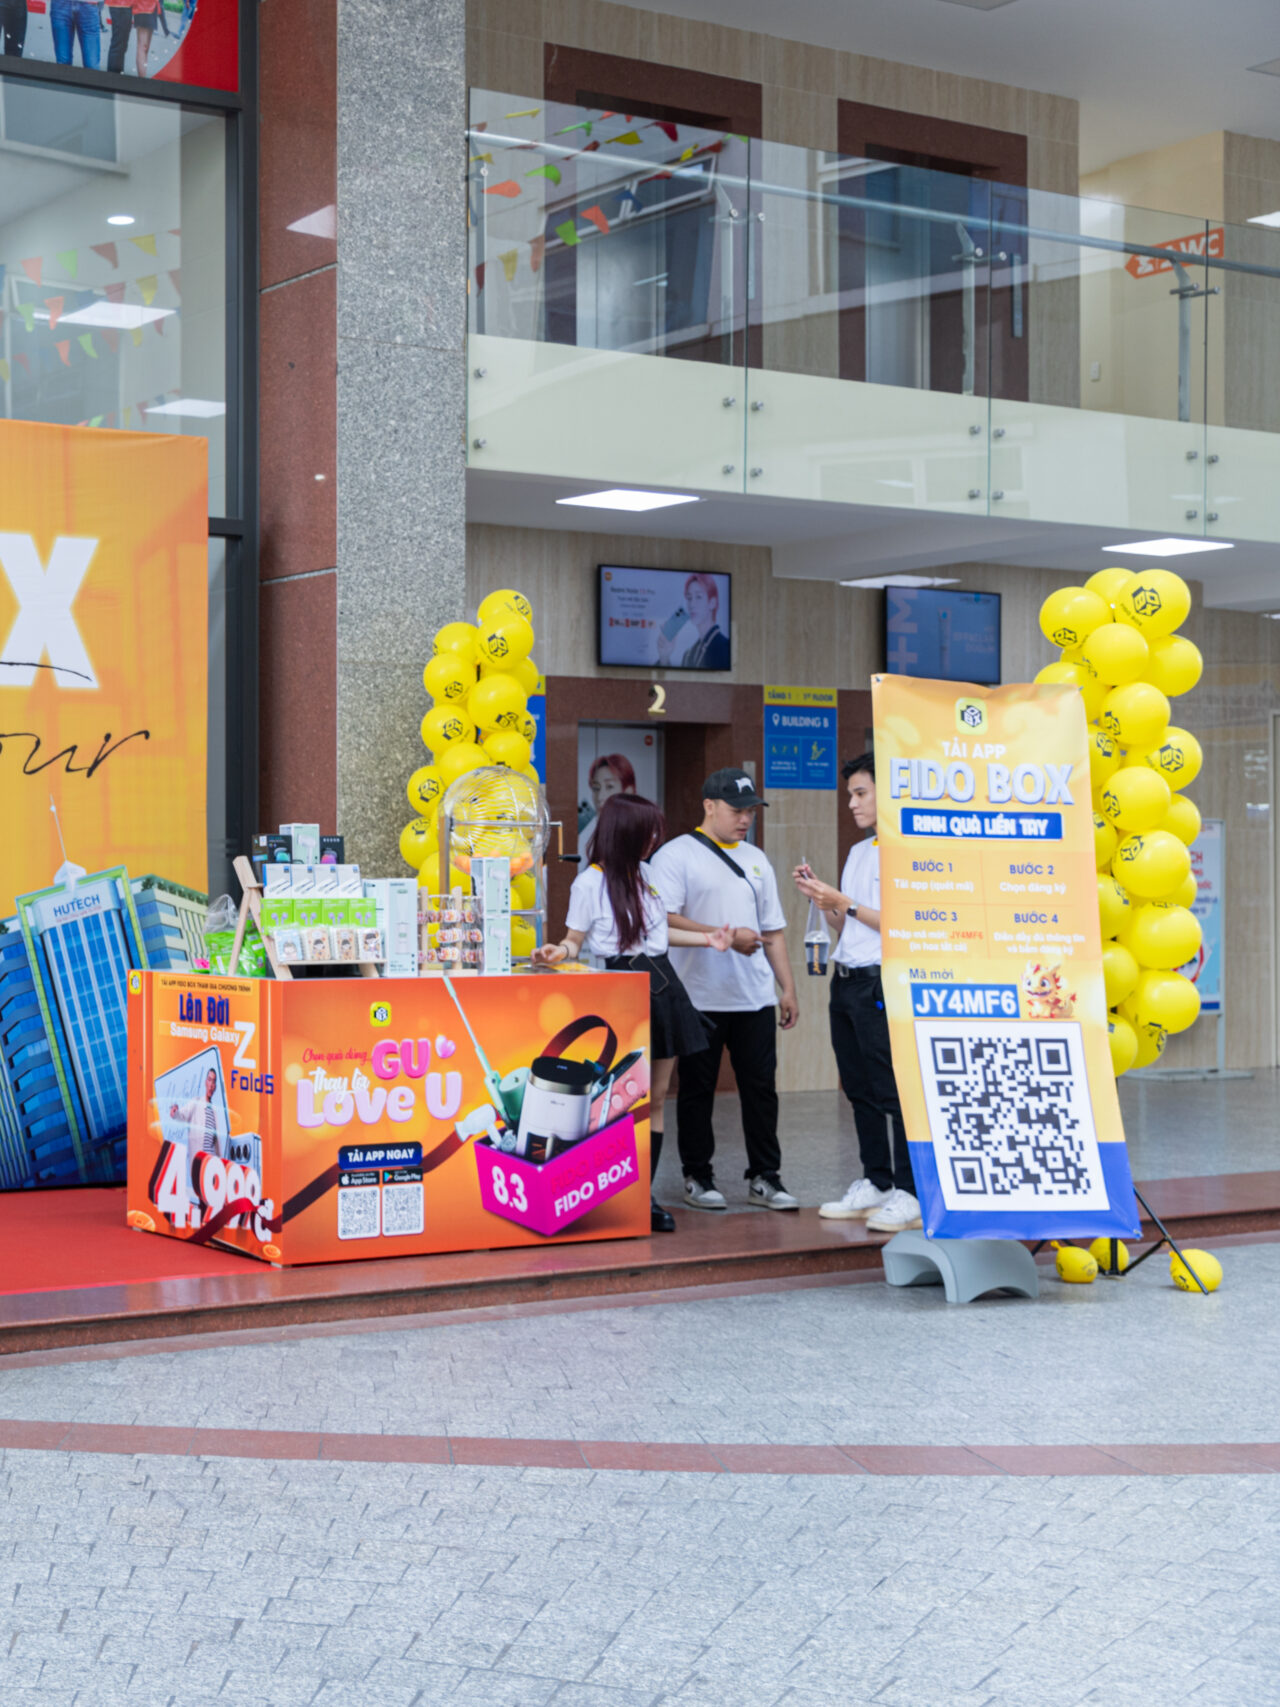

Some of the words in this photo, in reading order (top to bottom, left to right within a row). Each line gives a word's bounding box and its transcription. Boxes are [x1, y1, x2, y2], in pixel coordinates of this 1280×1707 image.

[1180, 234, 1219, 256] WC
[648, 684, 666, 713] 2
[782, 715, 822, 729] BUILDING
[941, 736, 967, 758] TẢI
[972, 743, 1007, 759] APP
[890, 757, 976, 803] FIDO
[987, 763, 1075, 806] BOX
[913, 814, 948, 833] RINH
[949, 814, 982, 836] QUÀ
[1019, 819, 1049, 836] TAY
[912, 859, 944, 873] BƯỚC
[948, 862, 954, 873] 1
[1009, 861, 1044, 875] BƯỚC
[1048, 865, 1055, 875] 2
[53, 894, 101, 917] HUTECH
[914, 907, 948, 921] BƯỚC
[951, 911, 958, 922] 3
[1014, 911, 1048, 924] BƯỚC
[1051, 913, 1059, 924] 4
[909, 968, 928, 979] Mã
[929, 968, 954, 980] mới
[179, 992, 203, 1024] Lên
[915, 988, 1018, 1016] JY4MF6
[170, 1021, 209, 1044] Samsung
[210, 1025, 241, 1048] Galaxy
[232, 1020, 257, 1070] Z
[371, 1037, 432, 1081] GU
[230, 1069, 275, 1096] Fold5
[308, 1066, 349, 1105] thay
[297, 1078, 416, 1129] Love
[425, 1071, 463, 1121] U
[347, 1148, 364, 1163] TẢI
[365, 1150, 385, 1162] APP
[386, 1148, 415, 1161] NGAY
[550, 1159, 590, 1195] FIDO
[592, 1136, 629, 1165] BOX
[492, 1165, 528, 1213] 8.3
[554, 1181, 594, 1218] FIDO
[597, 1156, 633, 1192] BOX
